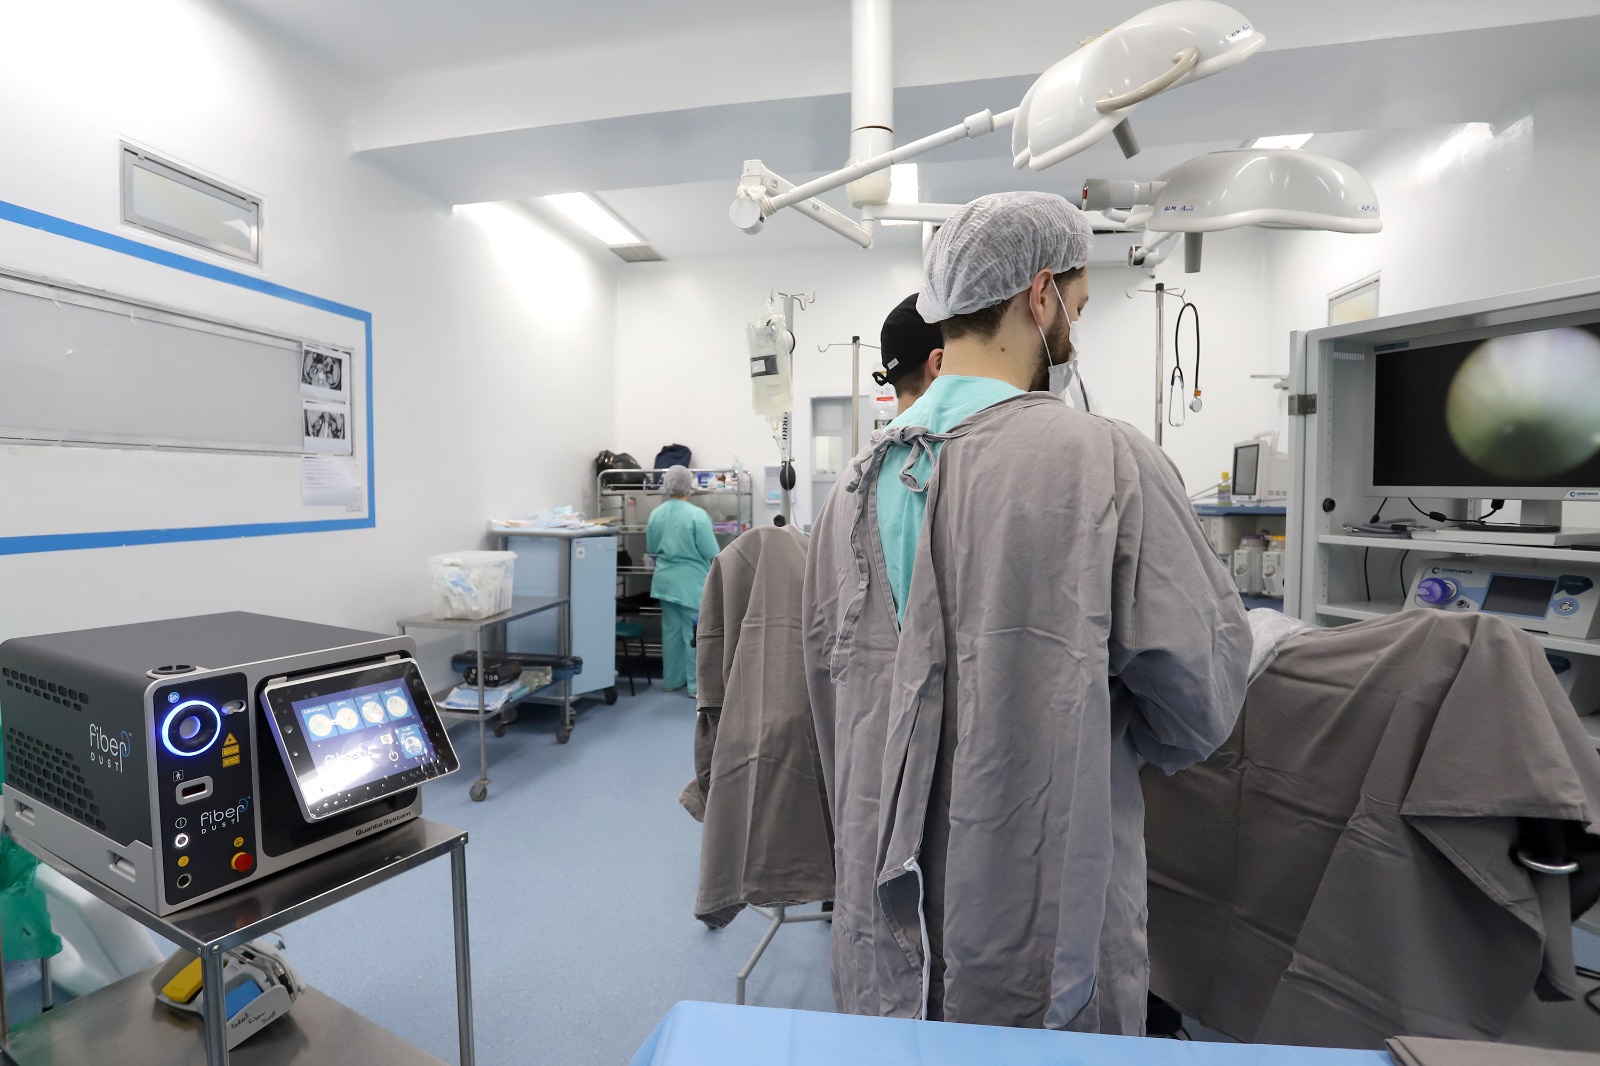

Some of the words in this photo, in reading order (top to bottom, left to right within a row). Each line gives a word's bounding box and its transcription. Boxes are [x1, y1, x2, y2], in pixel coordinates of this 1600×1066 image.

[90, 751, 119, 771] DUST
[201, 819, 236, 835] DUST
[355, 822, 383, 836] Quanta
[383, 811, 411, 826] System
